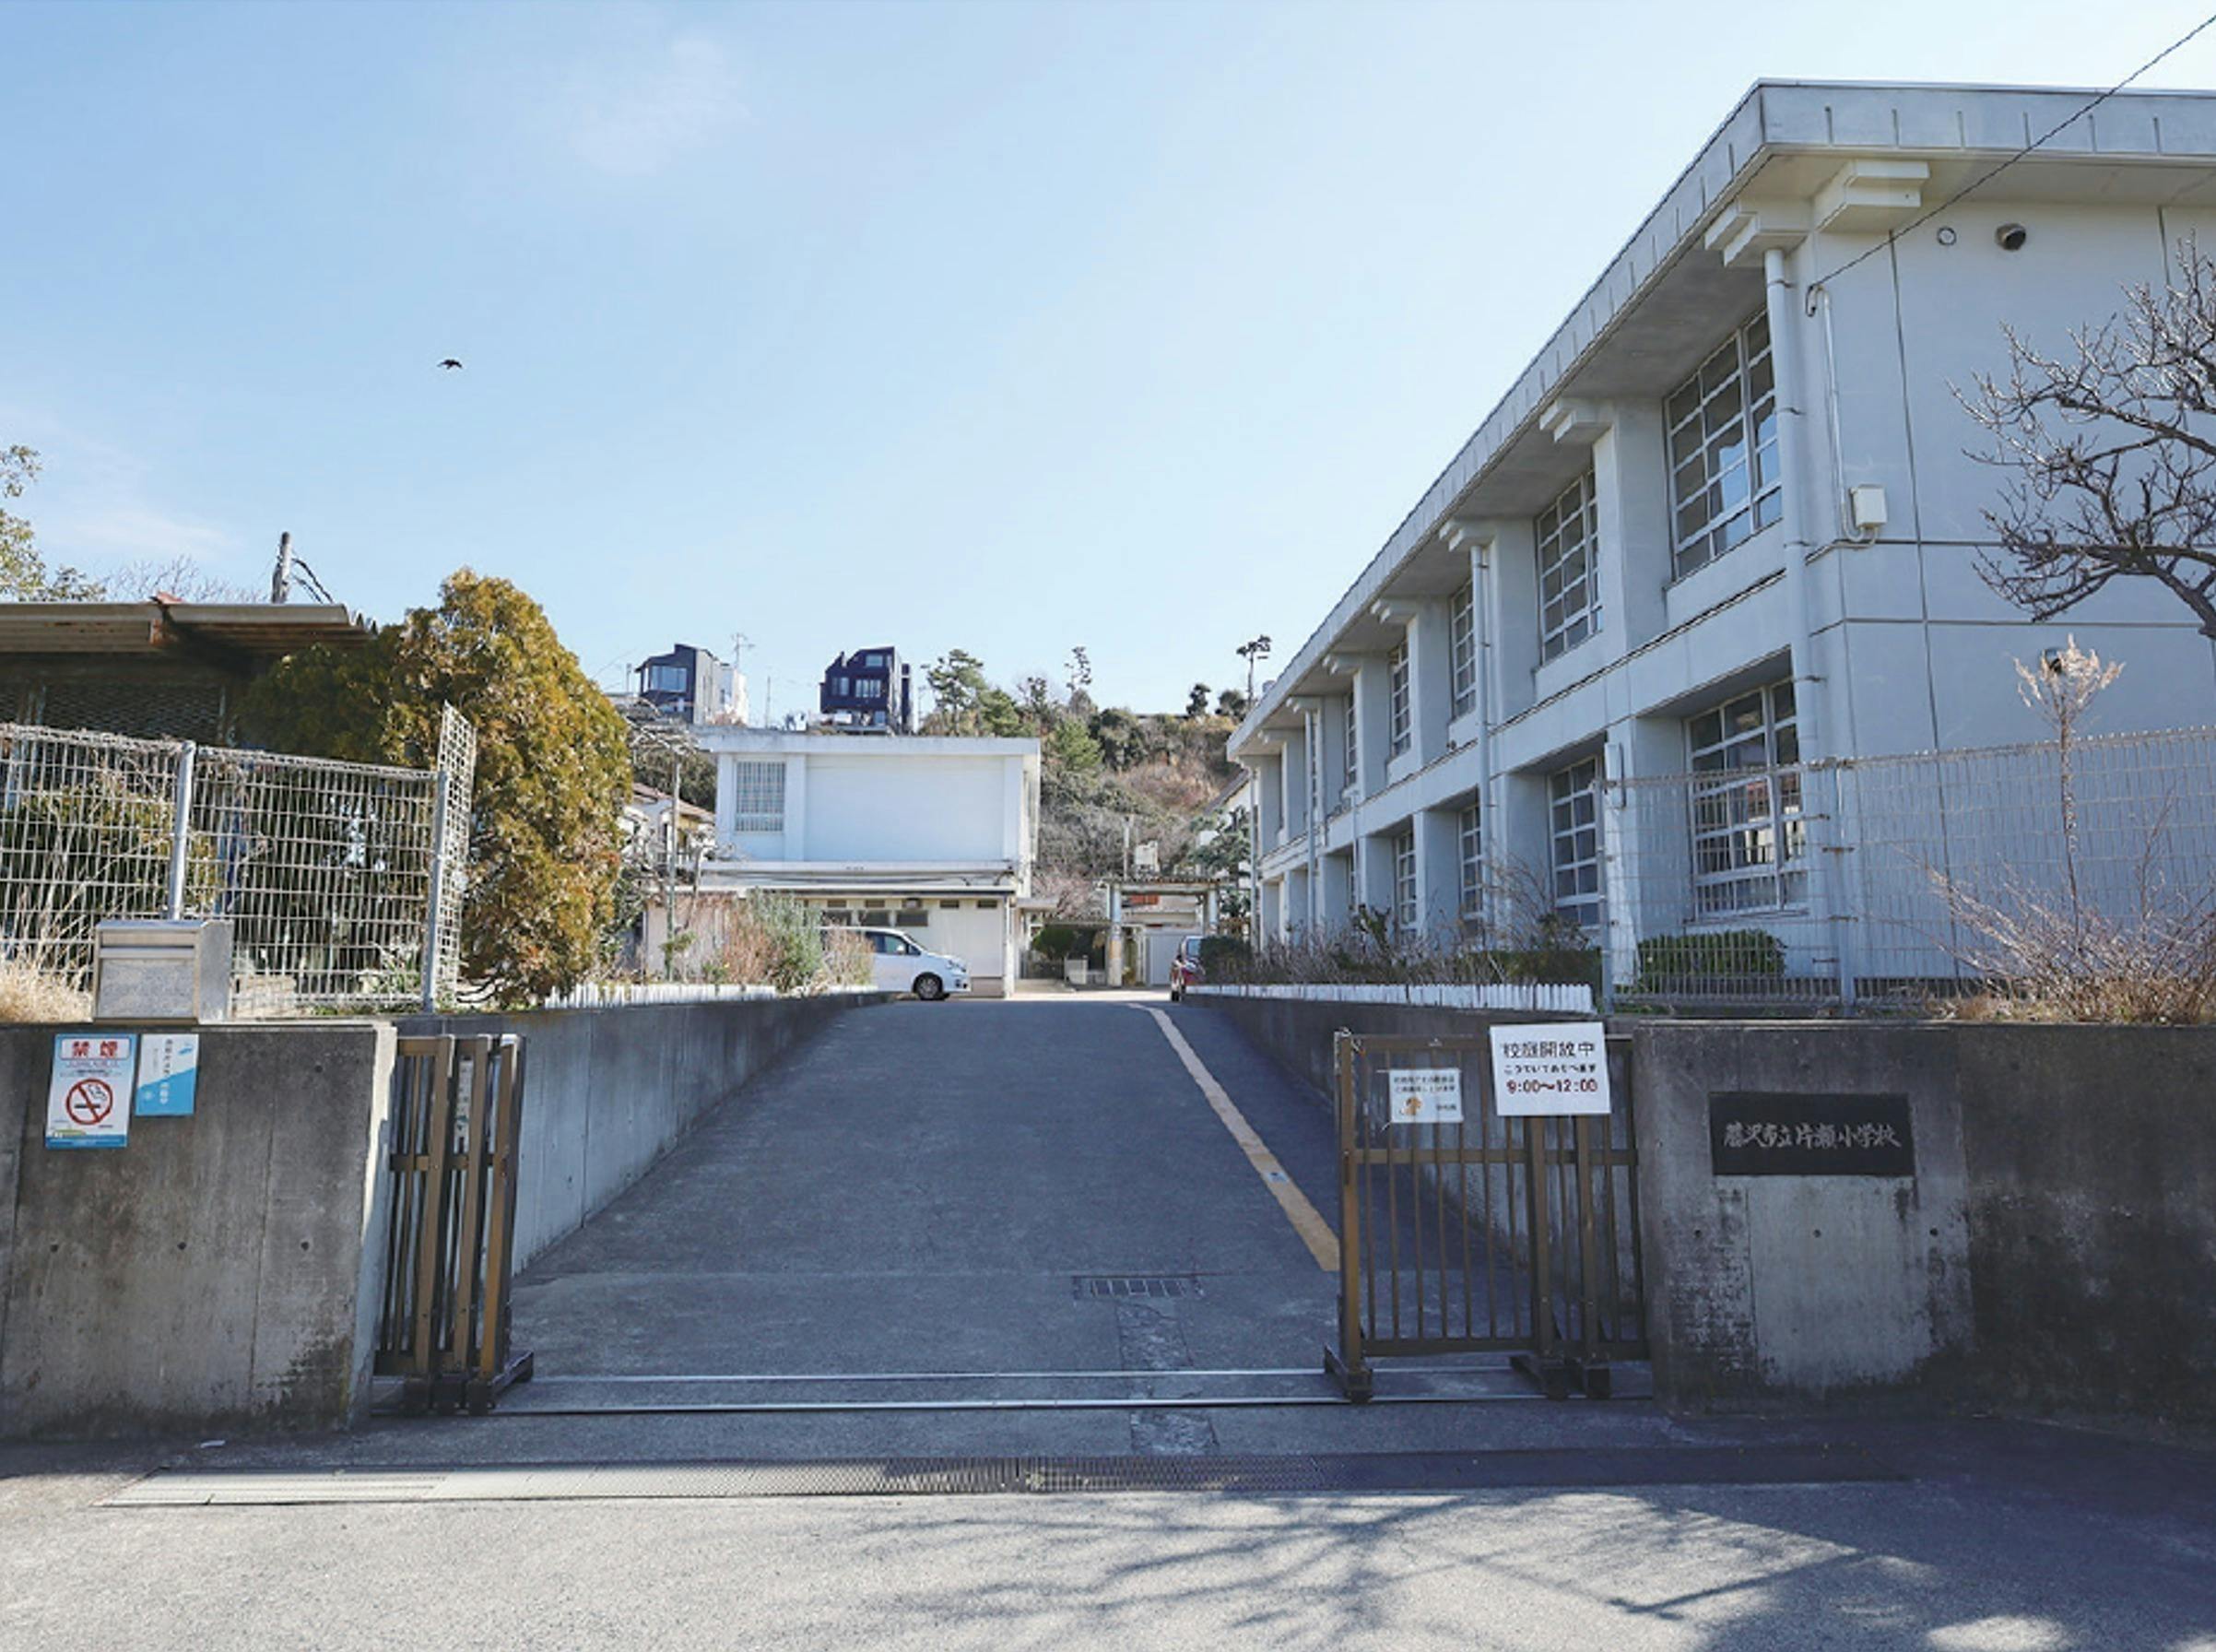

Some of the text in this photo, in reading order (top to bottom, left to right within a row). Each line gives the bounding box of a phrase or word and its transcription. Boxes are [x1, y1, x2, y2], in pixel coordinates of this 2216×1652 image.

[1503, 1041, 1595, 1058] 校庭開放中
[1724, 1122, 1902, 1149] 藤沢市立片瀬小学校
